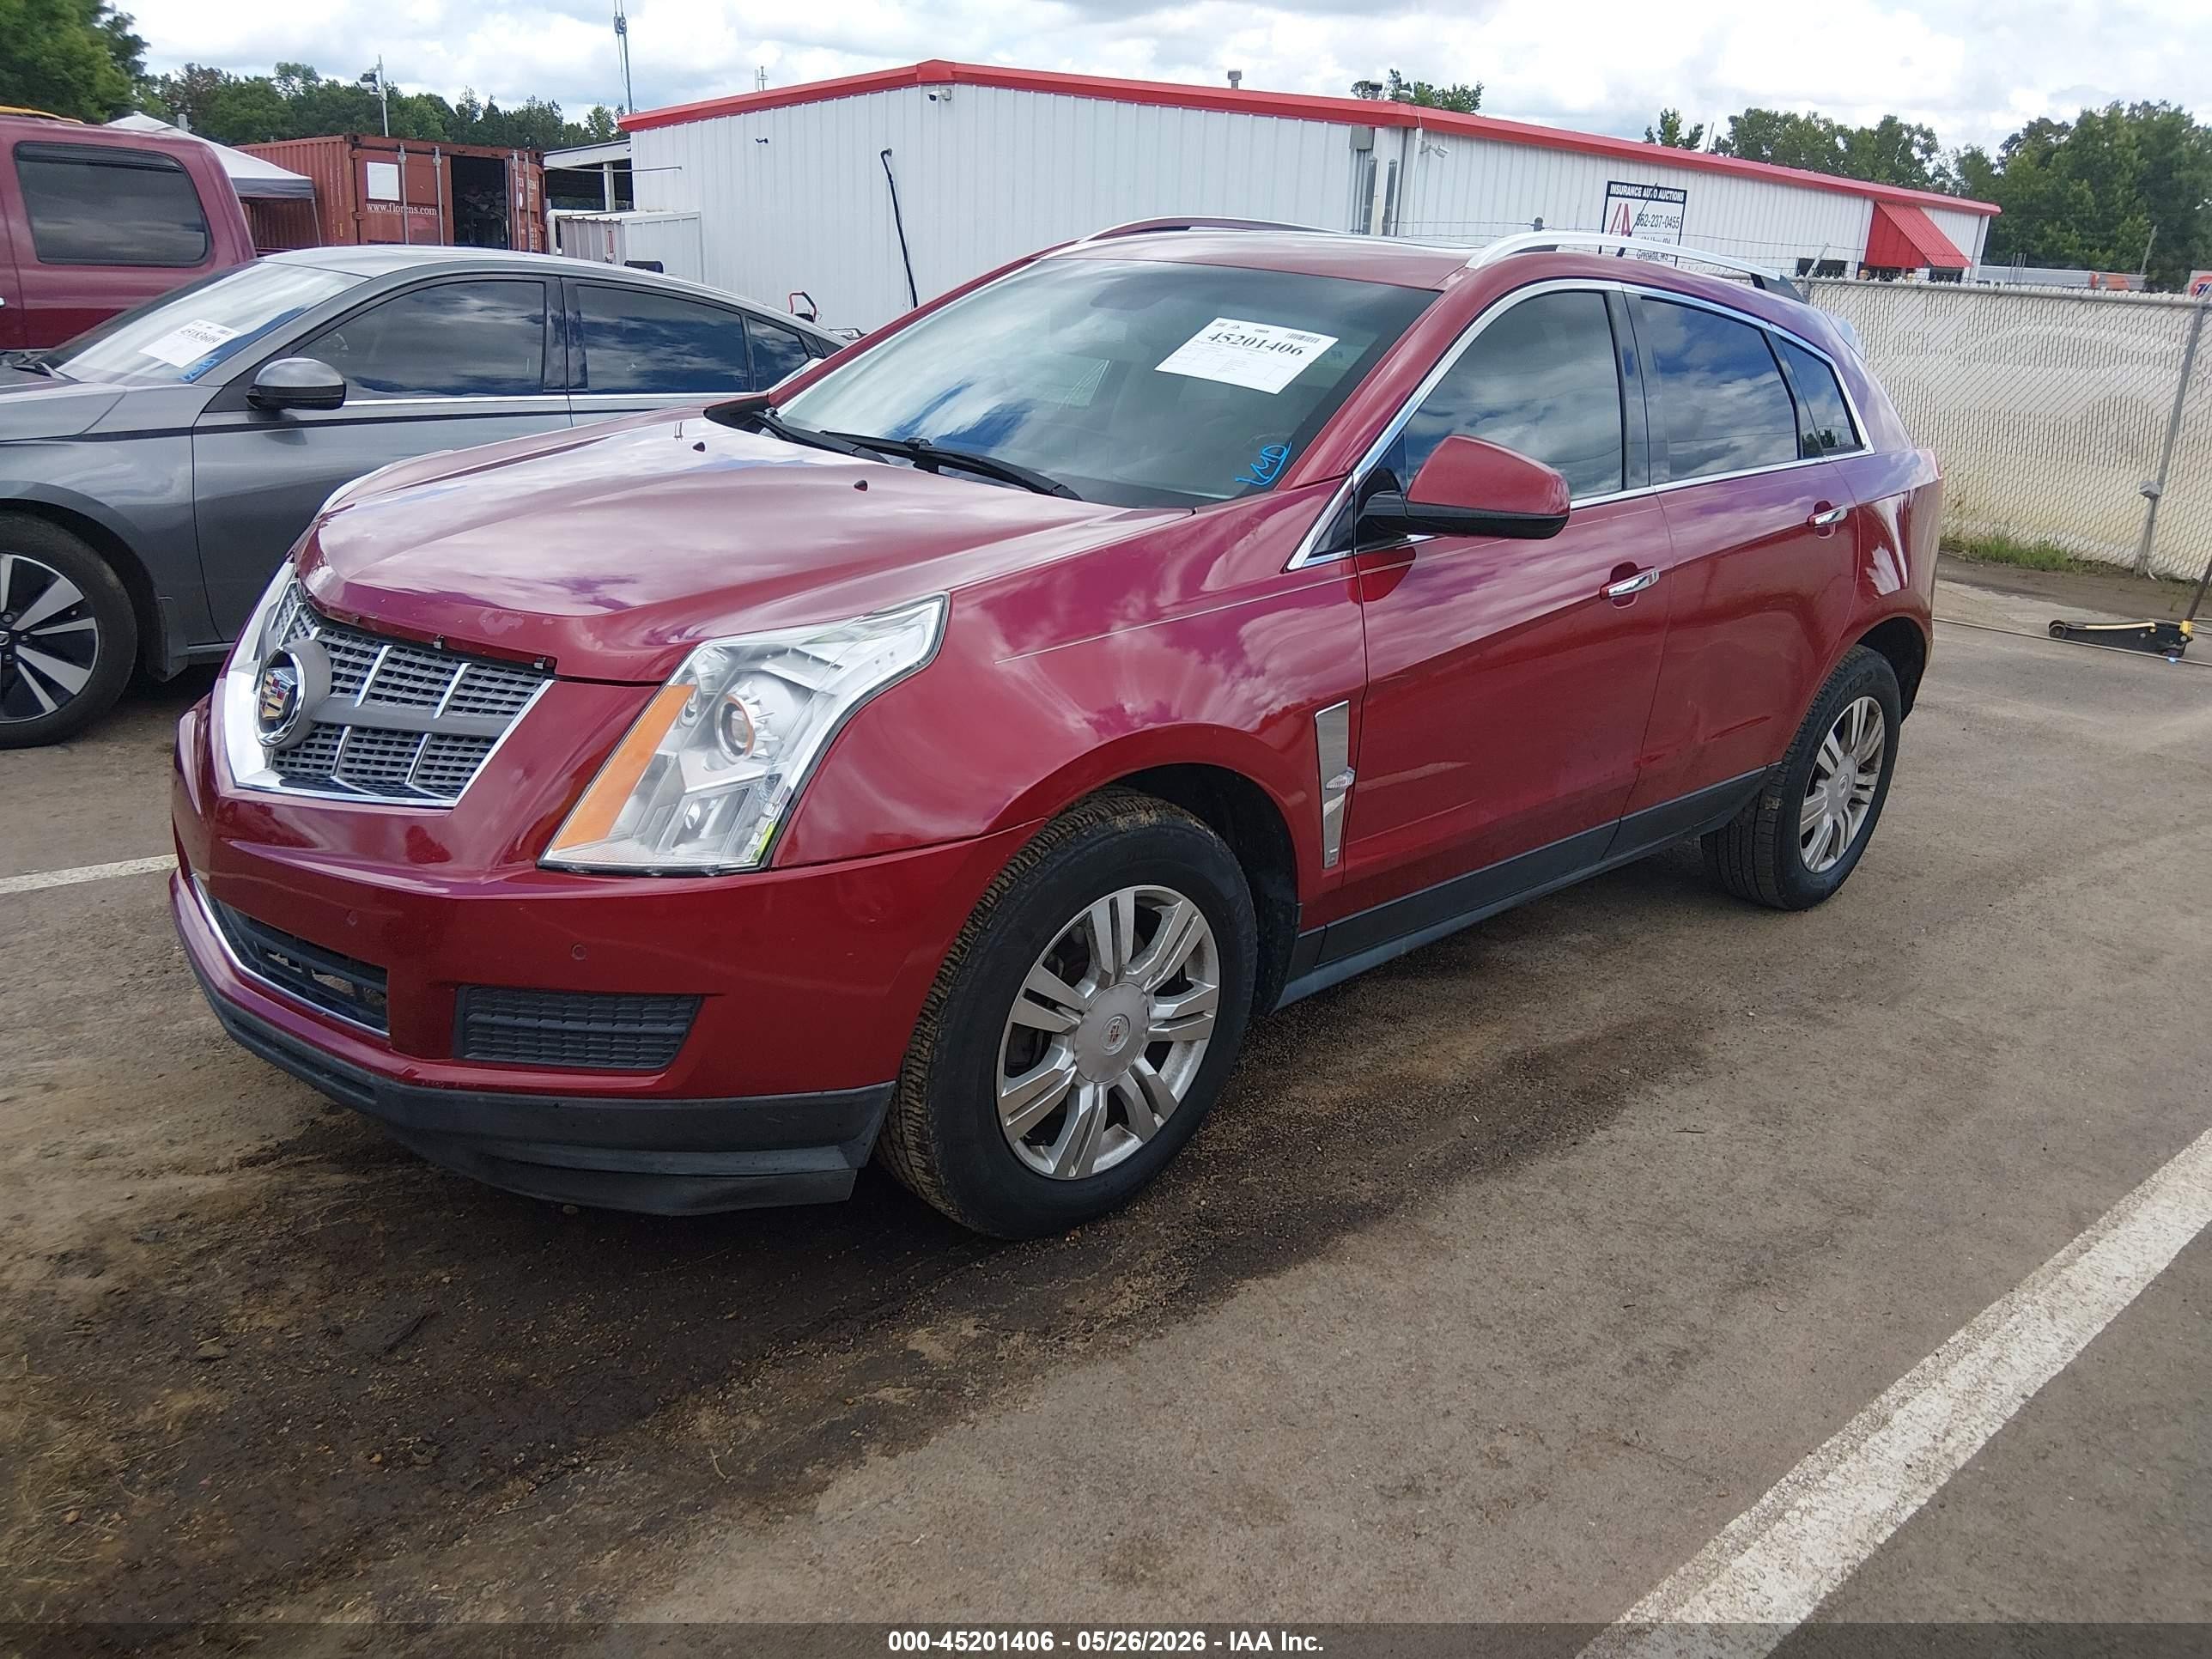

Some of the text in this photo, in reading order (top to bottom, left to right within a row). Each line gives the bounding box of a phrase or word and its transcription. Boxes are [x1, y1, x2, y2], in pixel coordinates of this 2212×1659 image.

[1610, 183, 1685, 202] INSURANCE AUTO AUCTIONS
[366, 203, 437, 216] www.florns.com
[1207, 331, 1308, 356] 45201406
